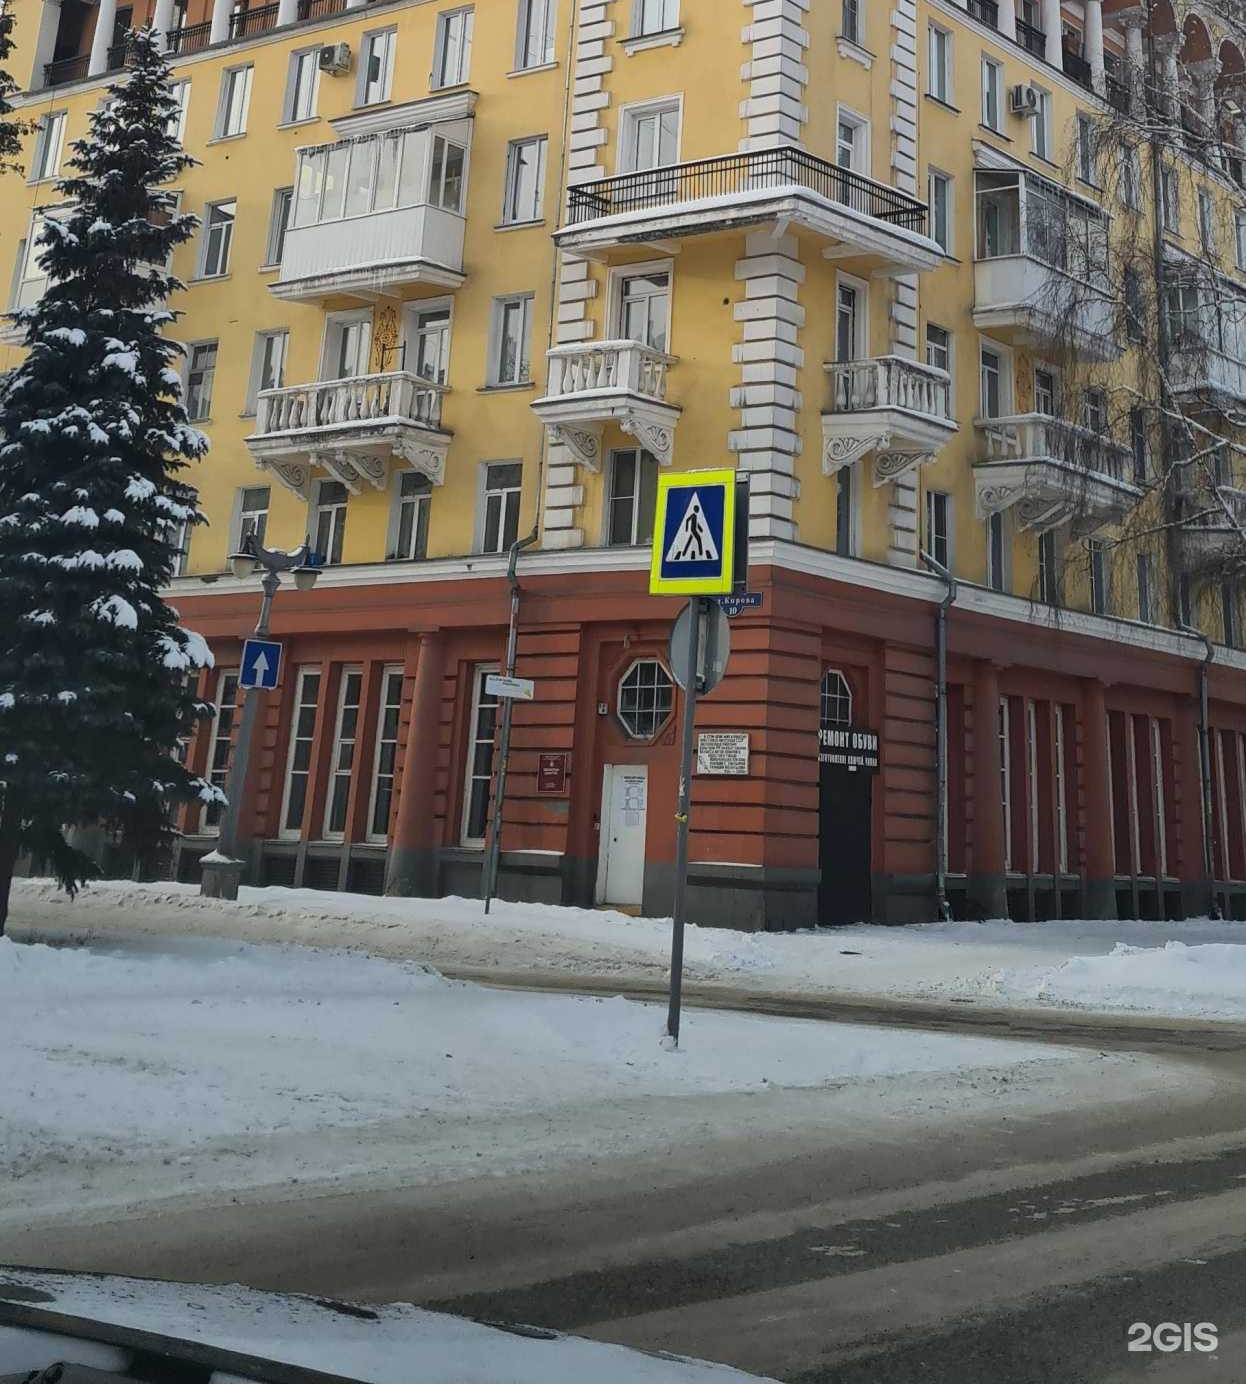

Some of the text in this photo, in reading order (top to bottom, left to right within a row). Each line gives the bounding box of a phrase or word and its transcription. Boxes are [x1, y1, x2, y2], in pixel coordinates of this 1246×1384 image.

[729, 606, 737, 615] 10
[818, 728, 878, 751] РЕМОНТ ОБУВИ
